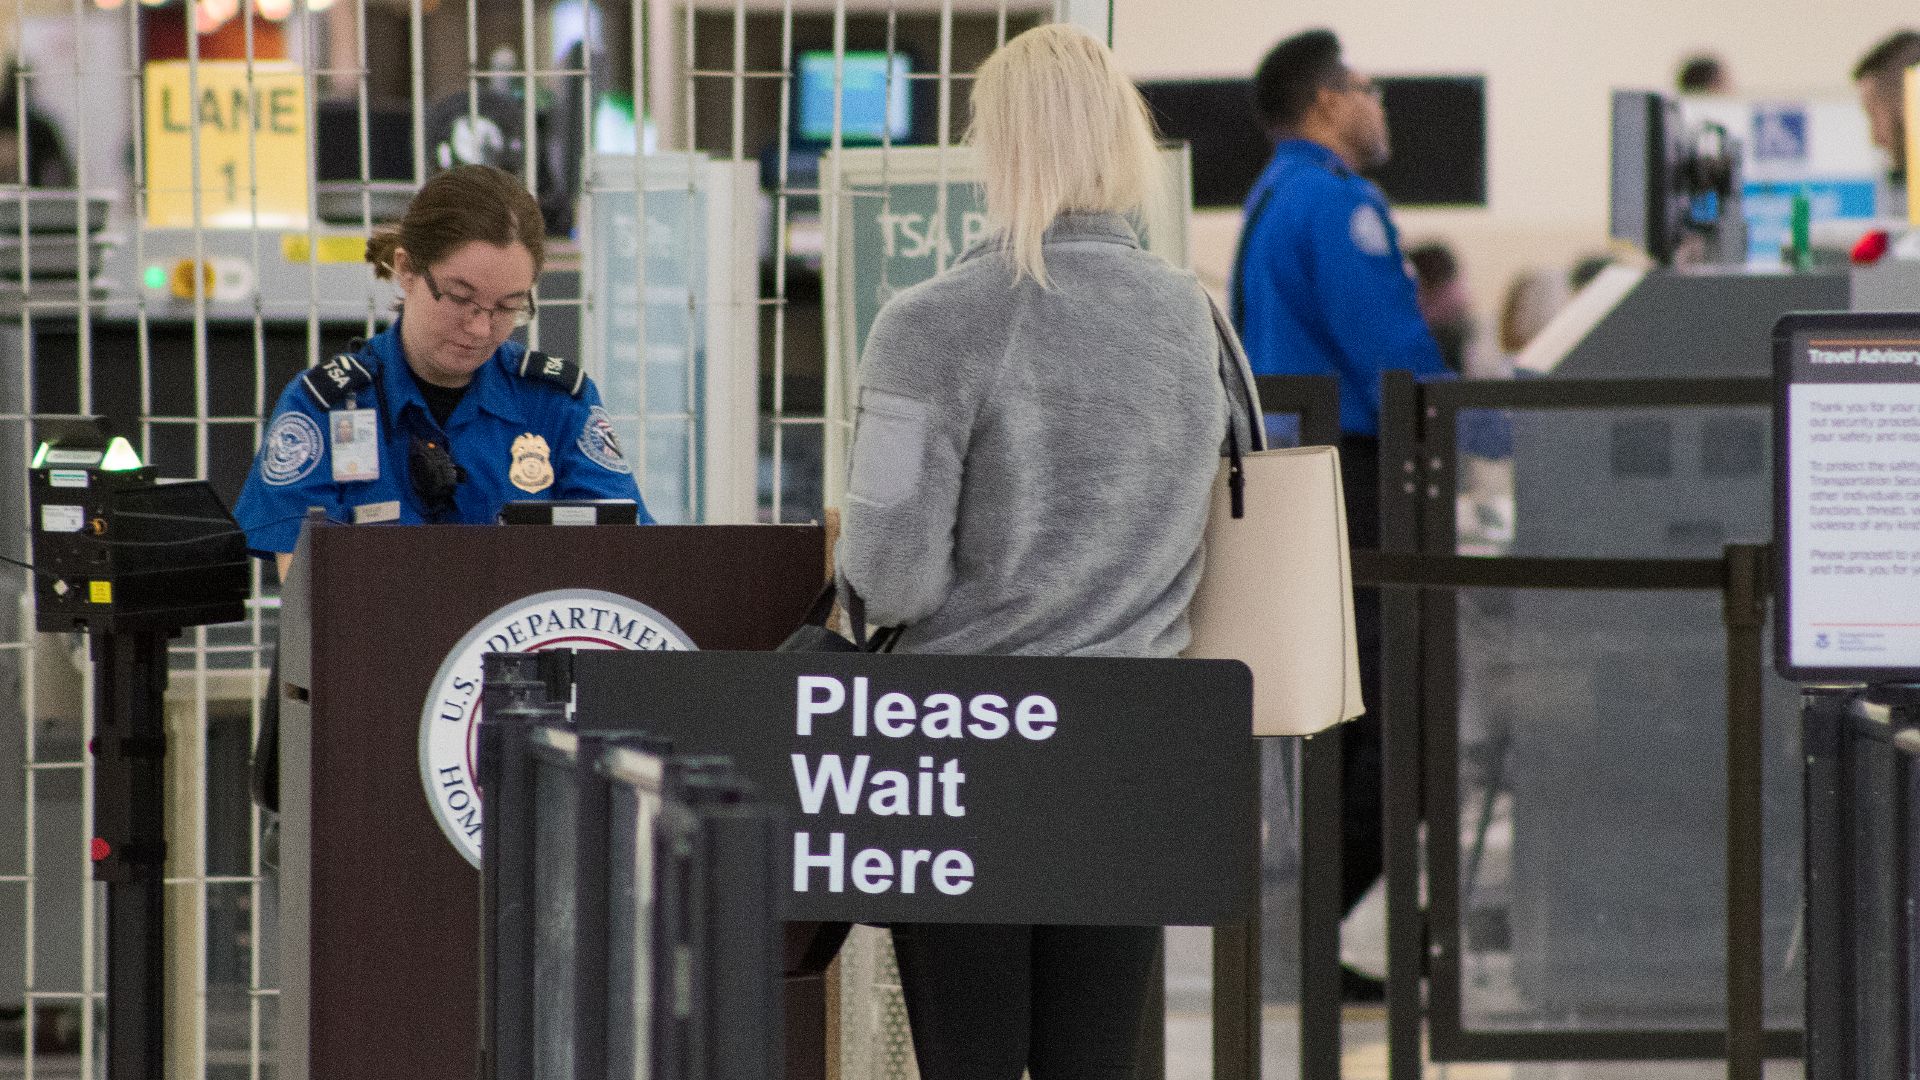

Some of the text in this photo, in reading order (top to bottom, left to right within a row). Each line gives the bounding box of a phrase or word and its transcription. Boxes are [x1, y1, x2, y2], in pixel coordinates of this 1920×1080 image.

[161, 87, 297, 133] LANE
[221, 161, 236, 204] 1
[876, 211, 988, 258] TSA P
[542, 356, 564, 376] TSA
[1808, 348, 1857, 364] Travel
[322, 358, 351, 389] TSA
[1809, 401, 1843, 413] Thank
[1846, 403, 1869, 414] you
[1888, 403, 1915, 414] your
[1830, 416, 1874, 430] security
[1809, 433, 1836, 444] your
[1839, 431, 1873, 445] safety
[1876, 431, 1897, 443] and
[1809, 461, 1822, 472] To
[1825, 461, 1865, 474] protect
[1867, 461, 1886, 472] the
[1809, 476, 1892, 488] Transportation
[1872, 522, 1894, 533] any
[1809, 549, 1845, 561] Please
[1809, 565, 1833, 576] and
[1868, 566, 1888, 577] you
[440, 676, 480, 723] U.S.
[796, 675, 1058, 741] Please
[790, 753, 966, 817] Wait
[440, 765, 482, 848] HOM
[793, 831, 975, 895] Here
